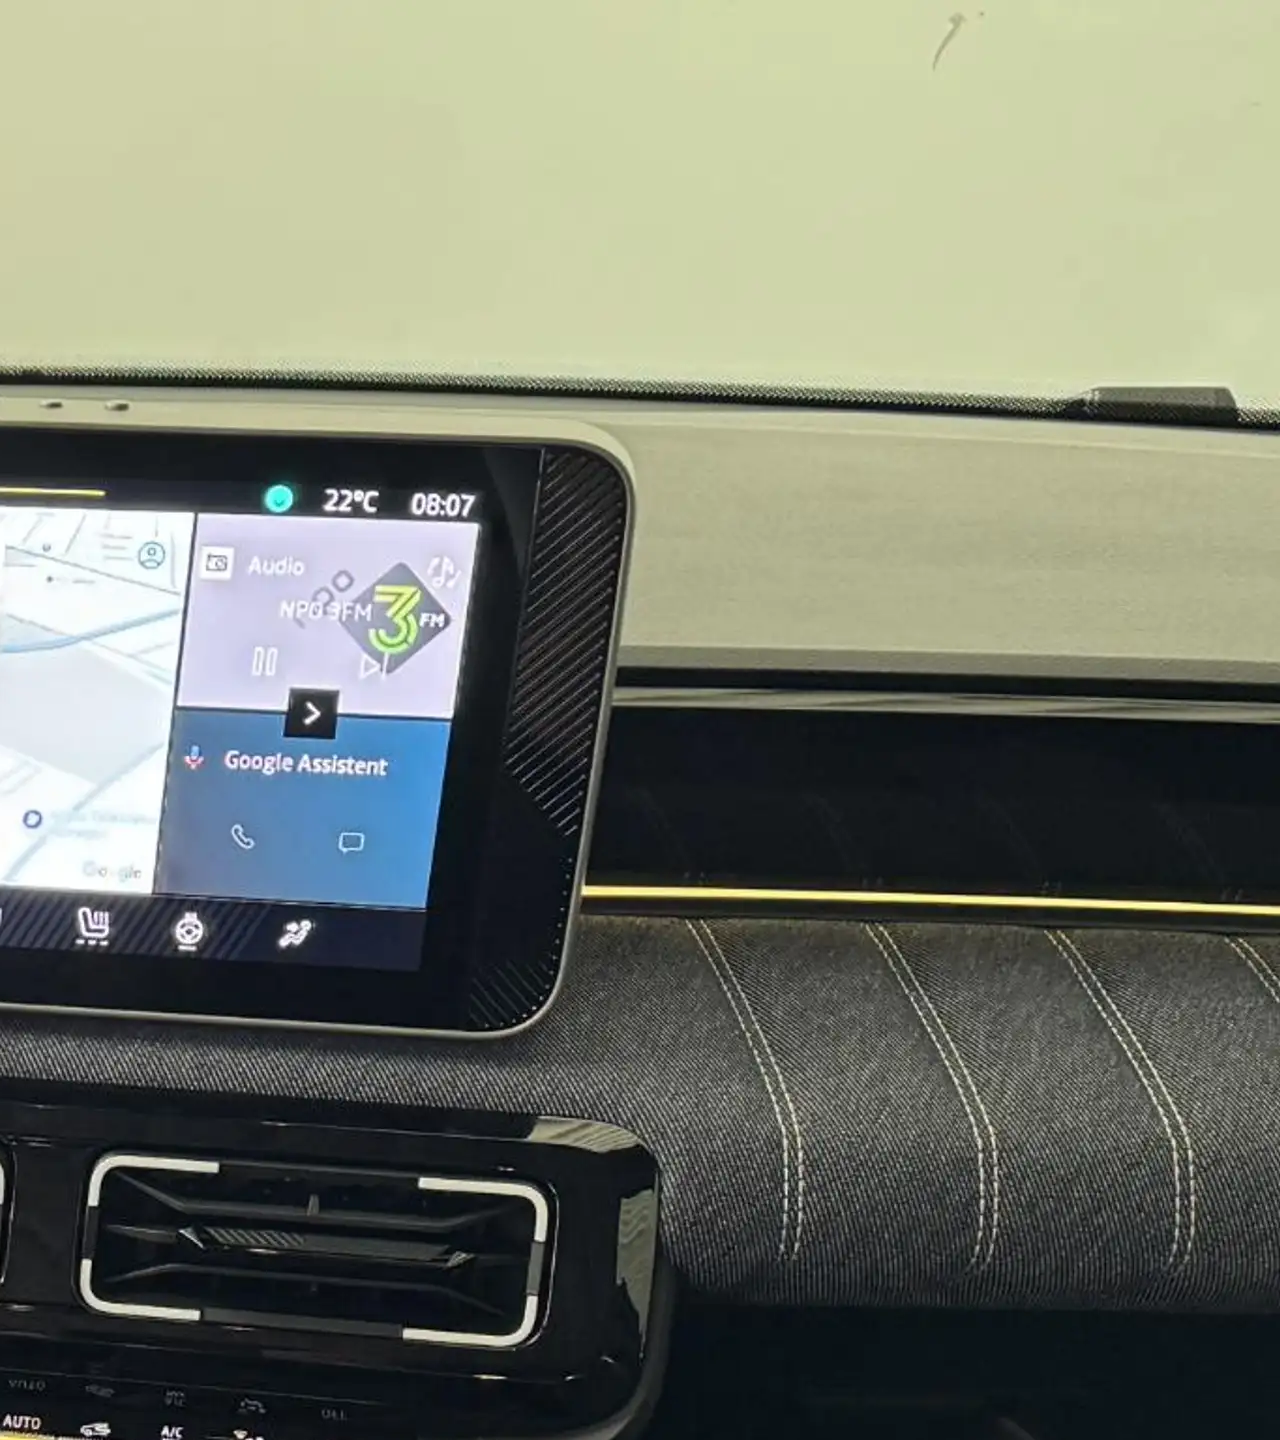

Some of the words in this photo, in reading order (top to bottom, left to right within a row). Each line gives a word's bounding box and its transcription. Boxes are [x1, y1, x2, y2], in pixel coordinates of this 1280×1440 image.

[411, 492, 476, 517] 08:07
[248, 555, 305, 576] Audio
[279, 599, 324, 619] NPO
[419, 612, 446, 628] FM
[224, 750, 294, 776] Google
[296, 753, 389, 777] Assistent
[2, 1413, 42, 1430] AUTO
[161, 1424, 185, 1439] A/C
